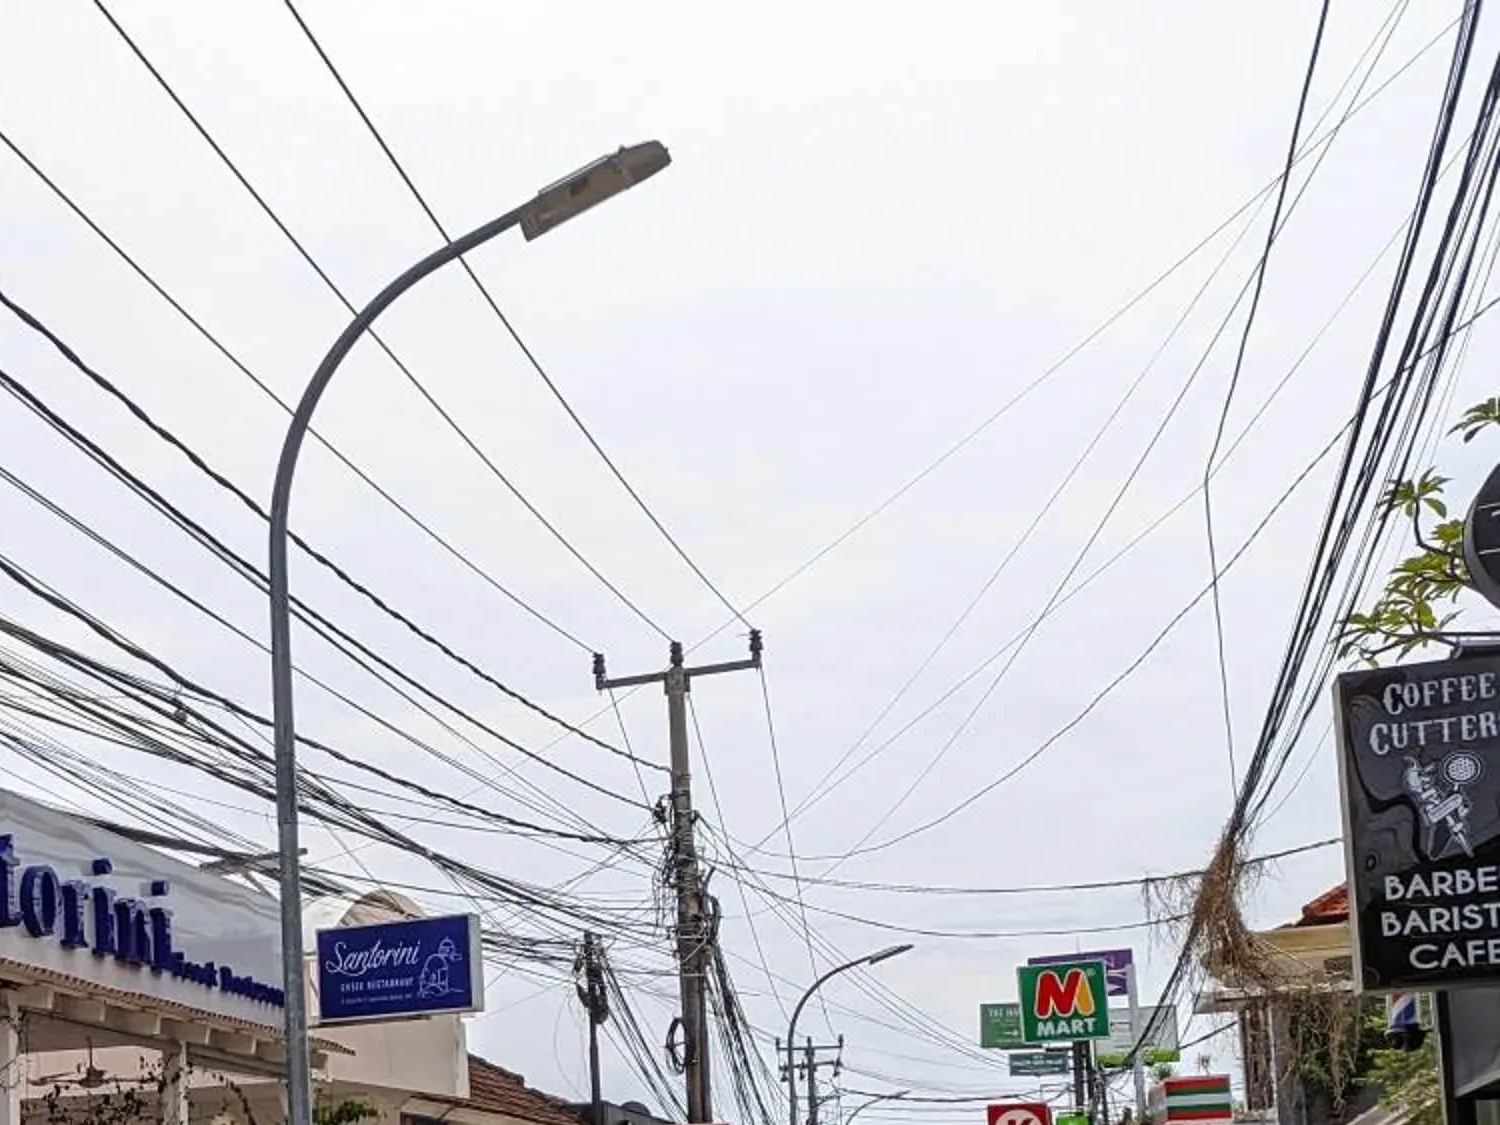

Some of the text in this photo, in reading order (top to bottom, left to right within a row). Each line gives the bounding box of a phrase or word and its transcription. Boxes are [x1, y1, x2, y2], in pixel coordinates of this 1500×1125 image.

[1383, 672, 1496, 714] COFFEE
[1369, 711, 1500, 755] CUTTER
[325, 939, 421, 977] Santorini
[1409, 939, 1500, 969] CAFE
[1037, 1018, 1097, 1037] MART
